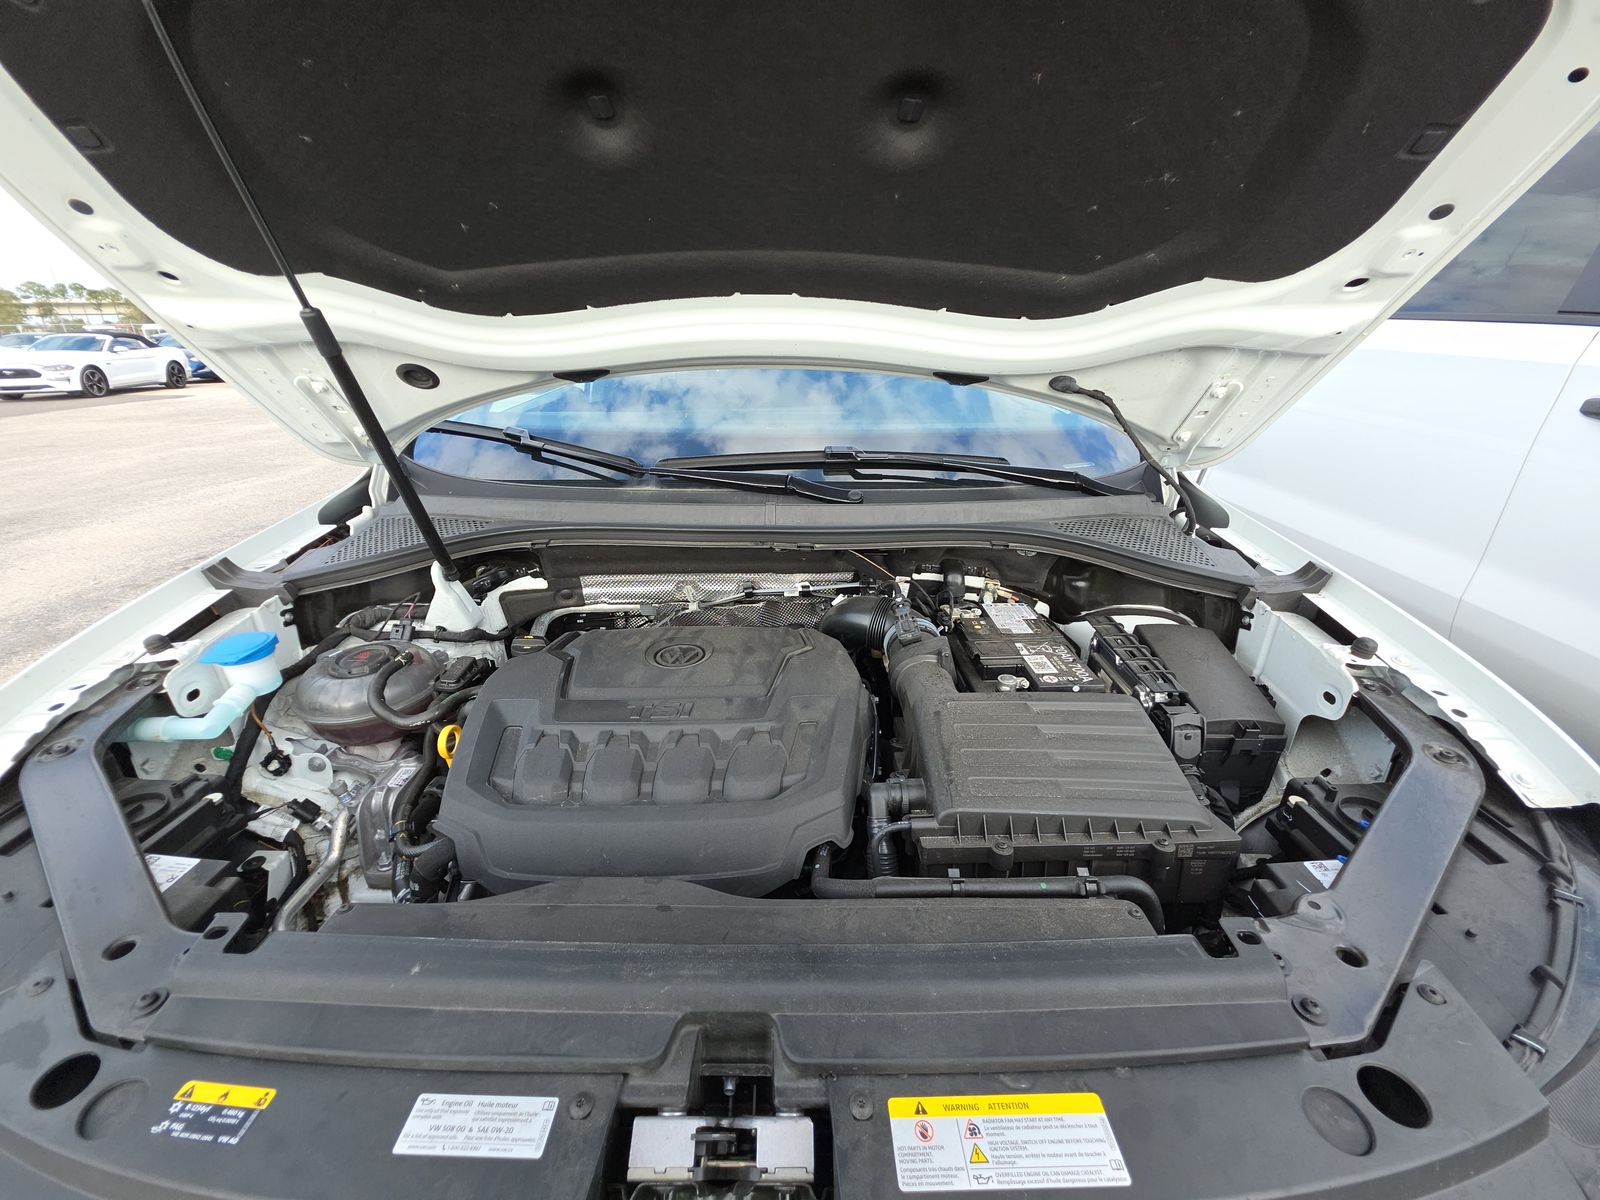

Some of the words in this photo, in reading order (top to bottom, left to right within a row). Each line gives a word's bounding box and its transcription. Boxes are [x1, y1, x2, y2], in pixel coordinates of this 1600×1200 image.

[626, 702, 696, 719] TSI
[441, 1099, 463, 1108] Engine
[943, 1103, 980, 1112] WARNING
[988, 1102, 1030, 1110] ATTENTION
